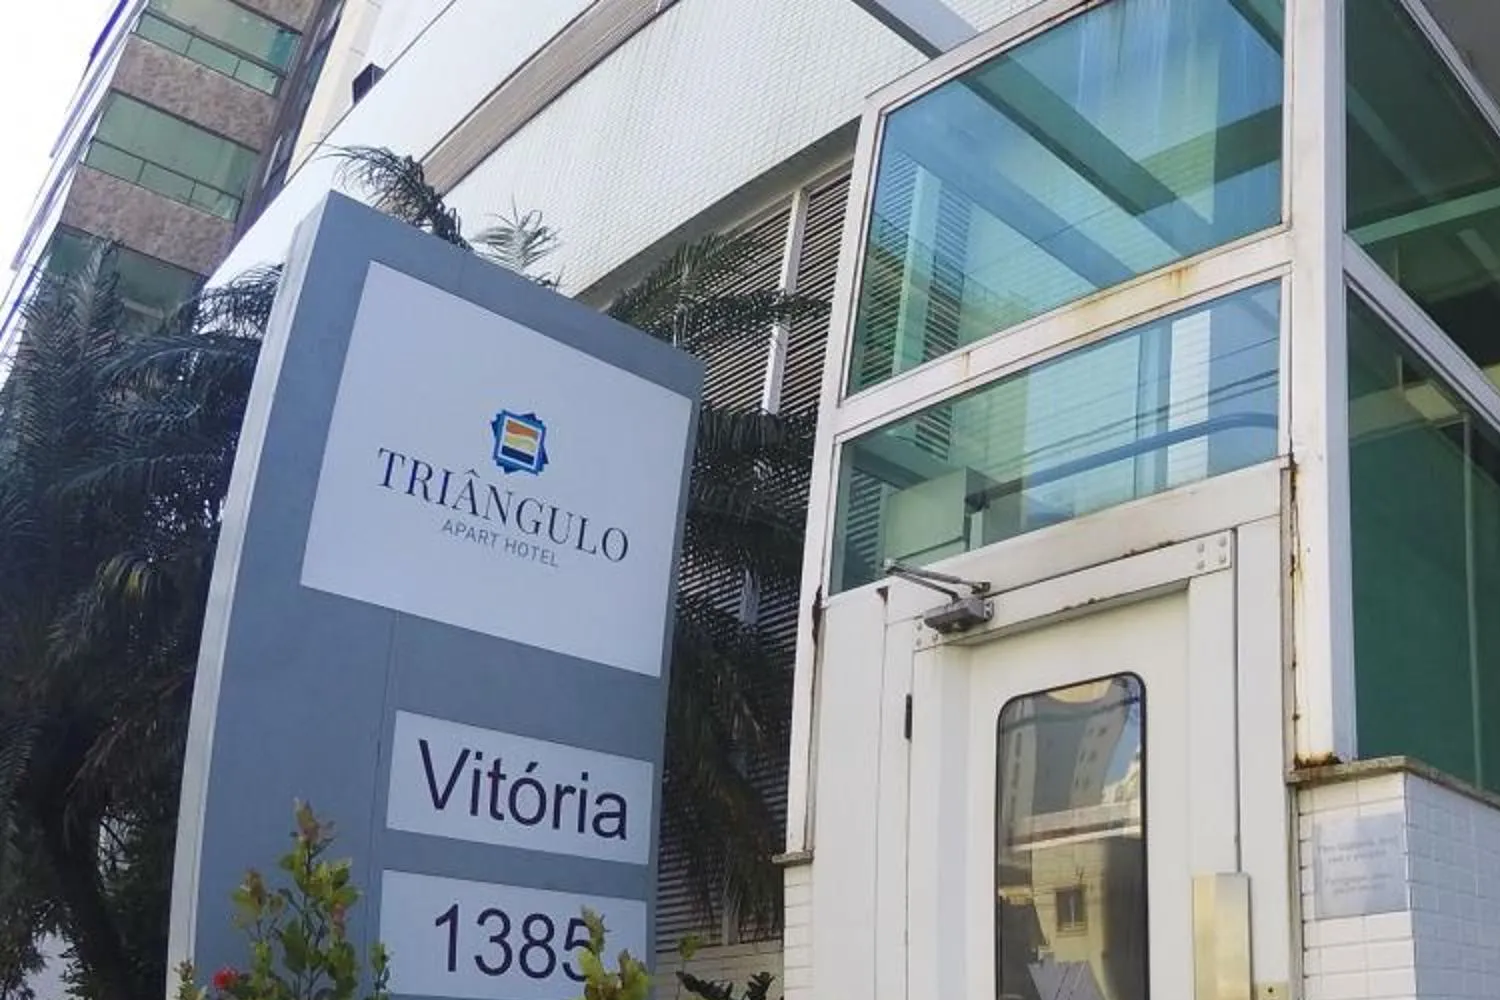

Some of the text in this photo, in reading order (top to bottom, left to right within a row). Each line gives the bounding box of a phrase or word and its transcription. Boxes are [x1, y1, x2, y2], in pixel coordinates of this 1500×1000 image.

[377, 447, 629, 563] TRIÂNGULO
[440, 518, 560, 568] APART HOTEL
[418, 738, 629, 841] Vitória
[434, 902, 593, 983] 1385
